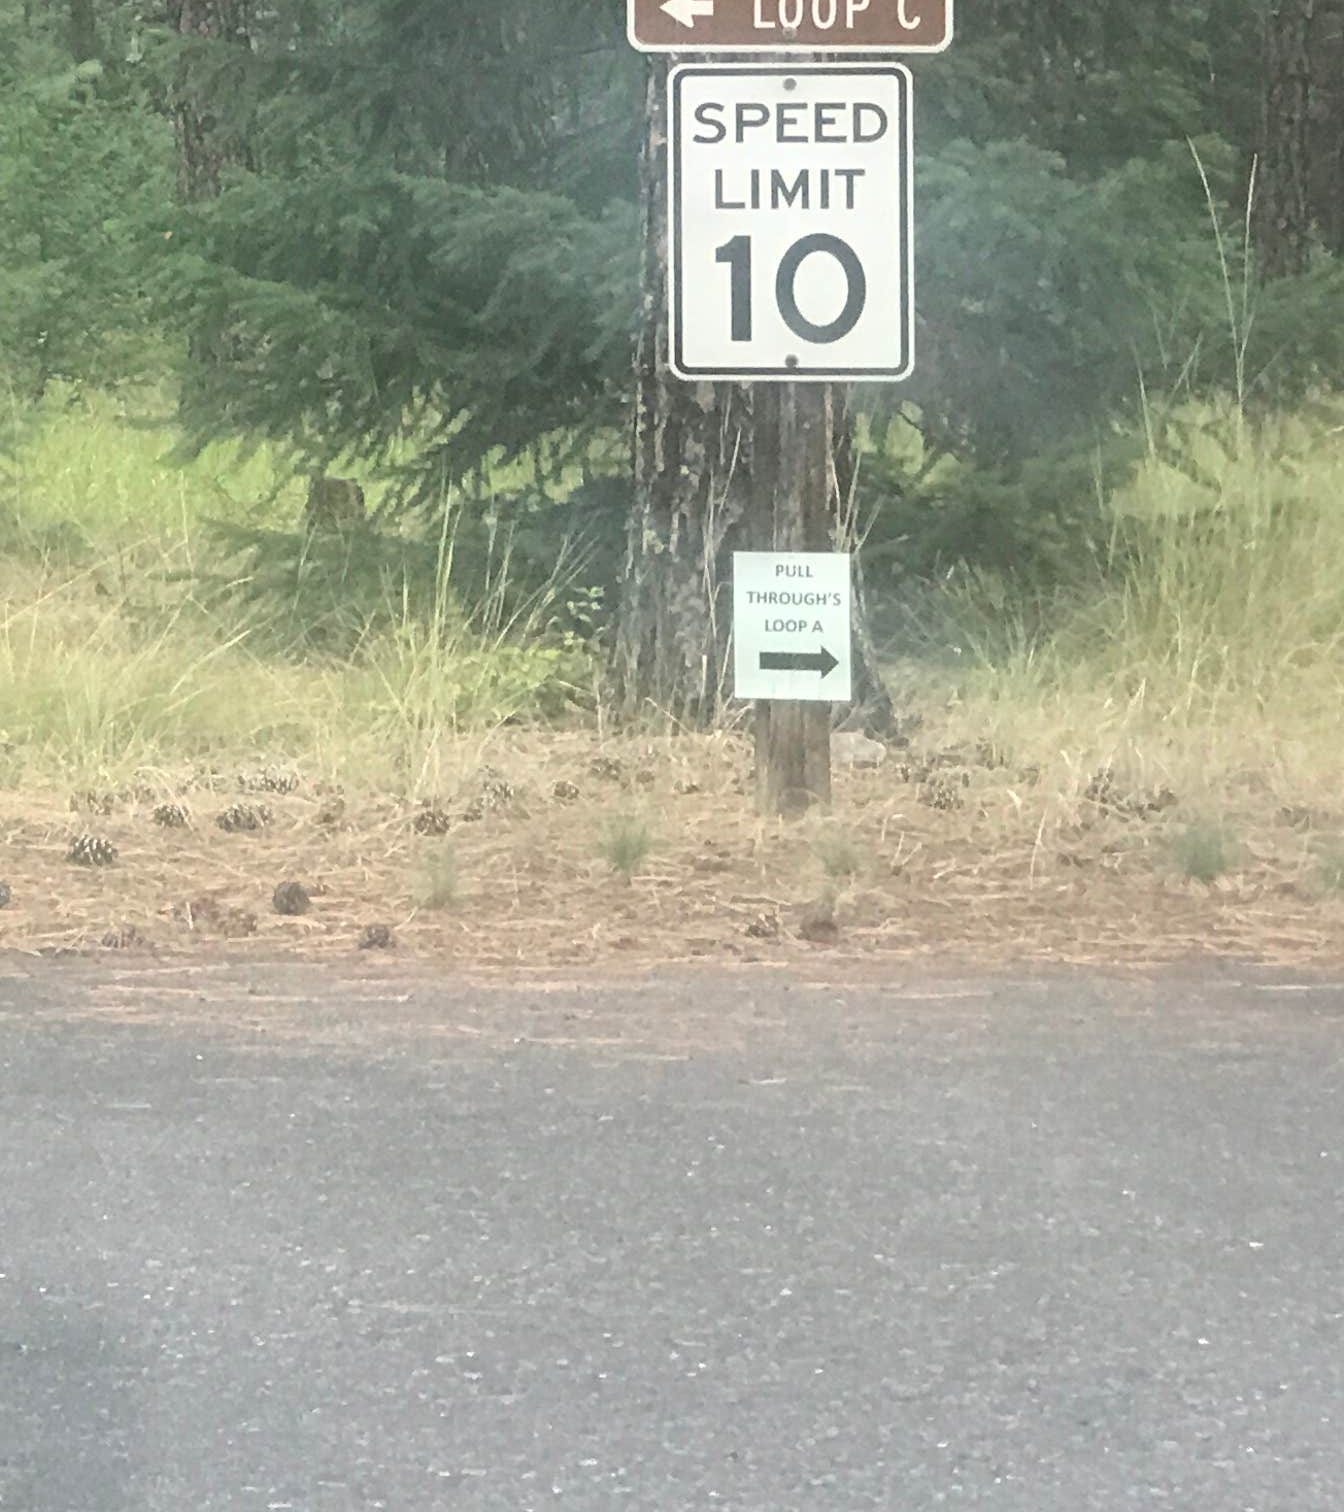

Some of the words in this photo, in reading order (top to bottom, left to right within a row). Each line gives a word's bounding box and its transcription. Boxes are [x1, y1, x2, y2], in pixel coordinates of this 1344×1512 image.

[692, 102, 888, 144] SPEED
[714, 169, 866, 209] LIMIT
[715, 232, 867, 344] 10
[775, 564, 814, 578] PULL
[746, 591, 842, 606] THROUGH'S
[765, 619, 807, 632] LOOP
[811, 620, 824, 633] A
